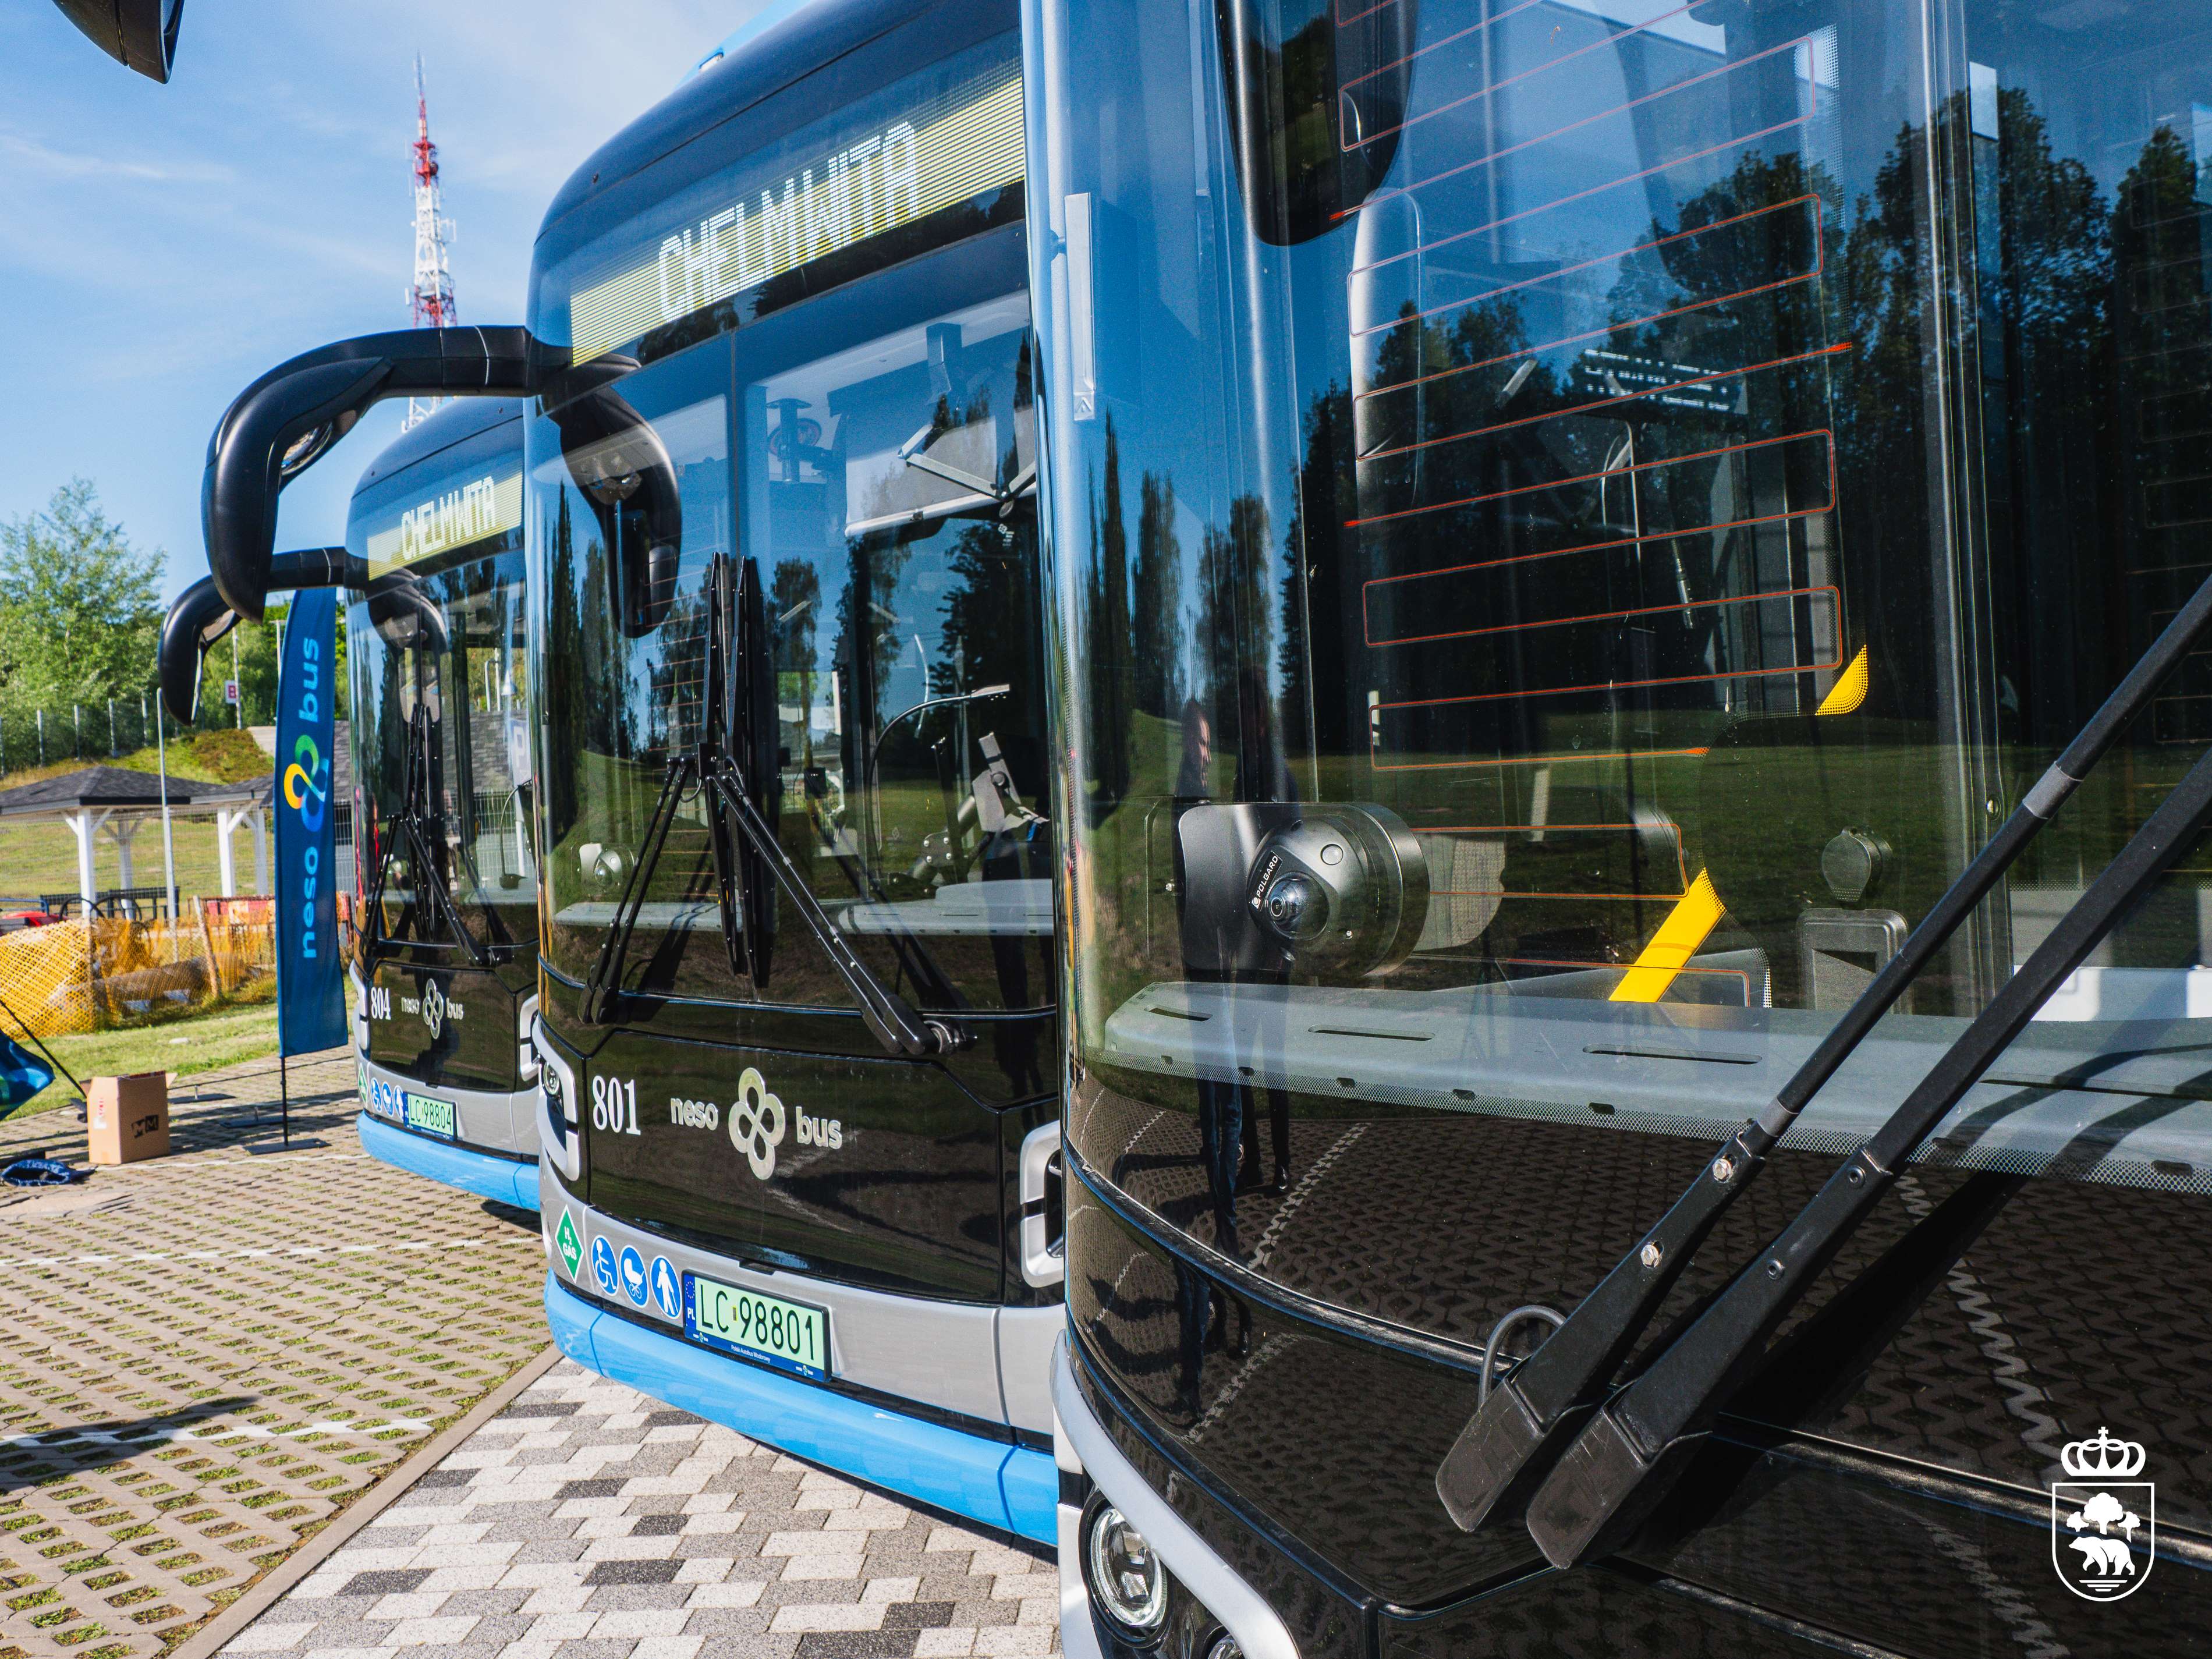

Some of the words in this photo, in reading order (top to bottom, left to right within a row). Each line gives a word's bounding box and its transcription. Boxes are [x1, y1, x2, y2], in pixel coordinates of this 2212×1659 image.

[299, 637, 320, 722] bus
[1256, 855, 1278, 898] POLGARD
[303, 846, 318, 958] neso
[370, 986, 391, 1020] 804
[446, 997, 464, 1020] bus
[409, 1097, 421, 1123] LC
[424, 1101, 452, 1132] 98804
[592, 1075, 641, 1136] 801
[671, 1098, 718, 1130] neso
[795, 1106, 842, 1150] bus
[562, 1242, 577, 1261] GAS
[687, 1307, 696, 1321] PL
[700, 1284, 729, 1333] LC
[739, 1296, 814, 1360] 98801
